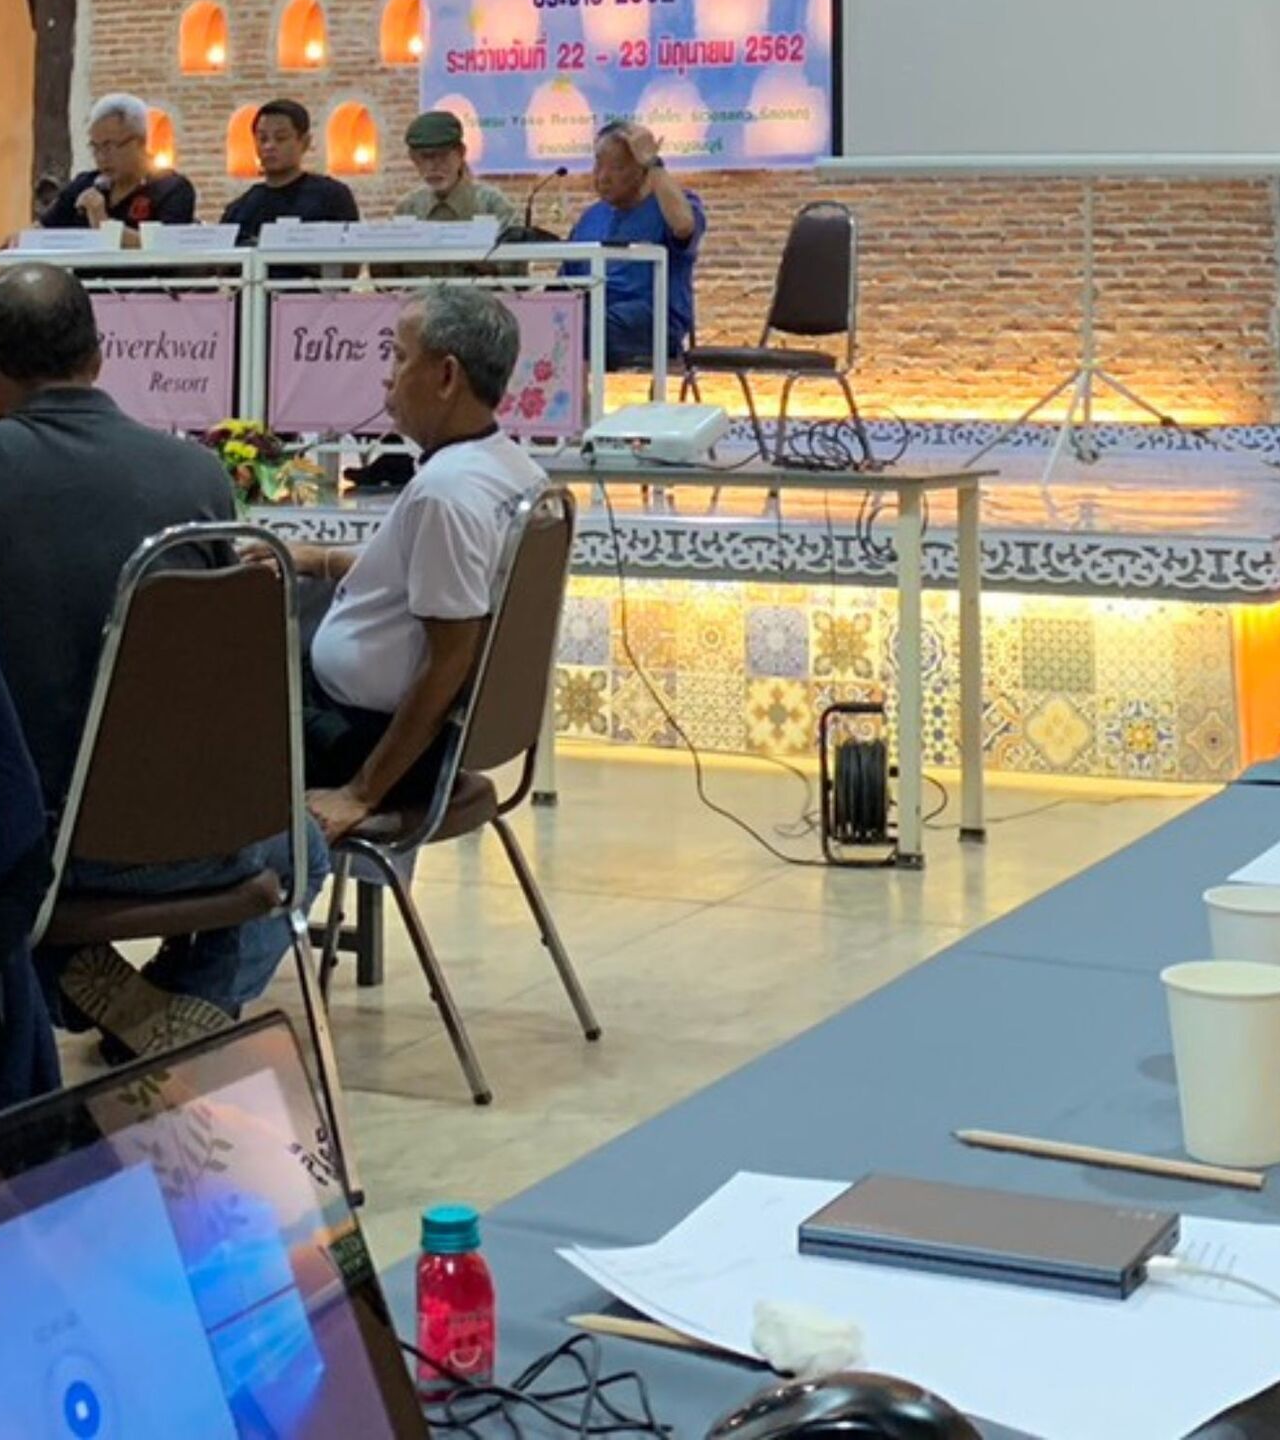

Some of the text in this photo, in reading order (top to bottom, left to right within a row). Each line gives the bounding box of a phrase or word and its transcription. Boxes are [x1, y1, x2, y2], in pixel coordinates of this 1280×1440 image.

[446, 33, 548, 75] ระหว่างวันที่
[556, 42, 586, 71] 22
[619, 38, 650, 68] 23
[658, 34, 736, 75] มิถุนายน
[745, 34, 806, 64] 2562
[293, 327, 368, 361] โยโกะ
[148, 371, 210, 393] Resort
